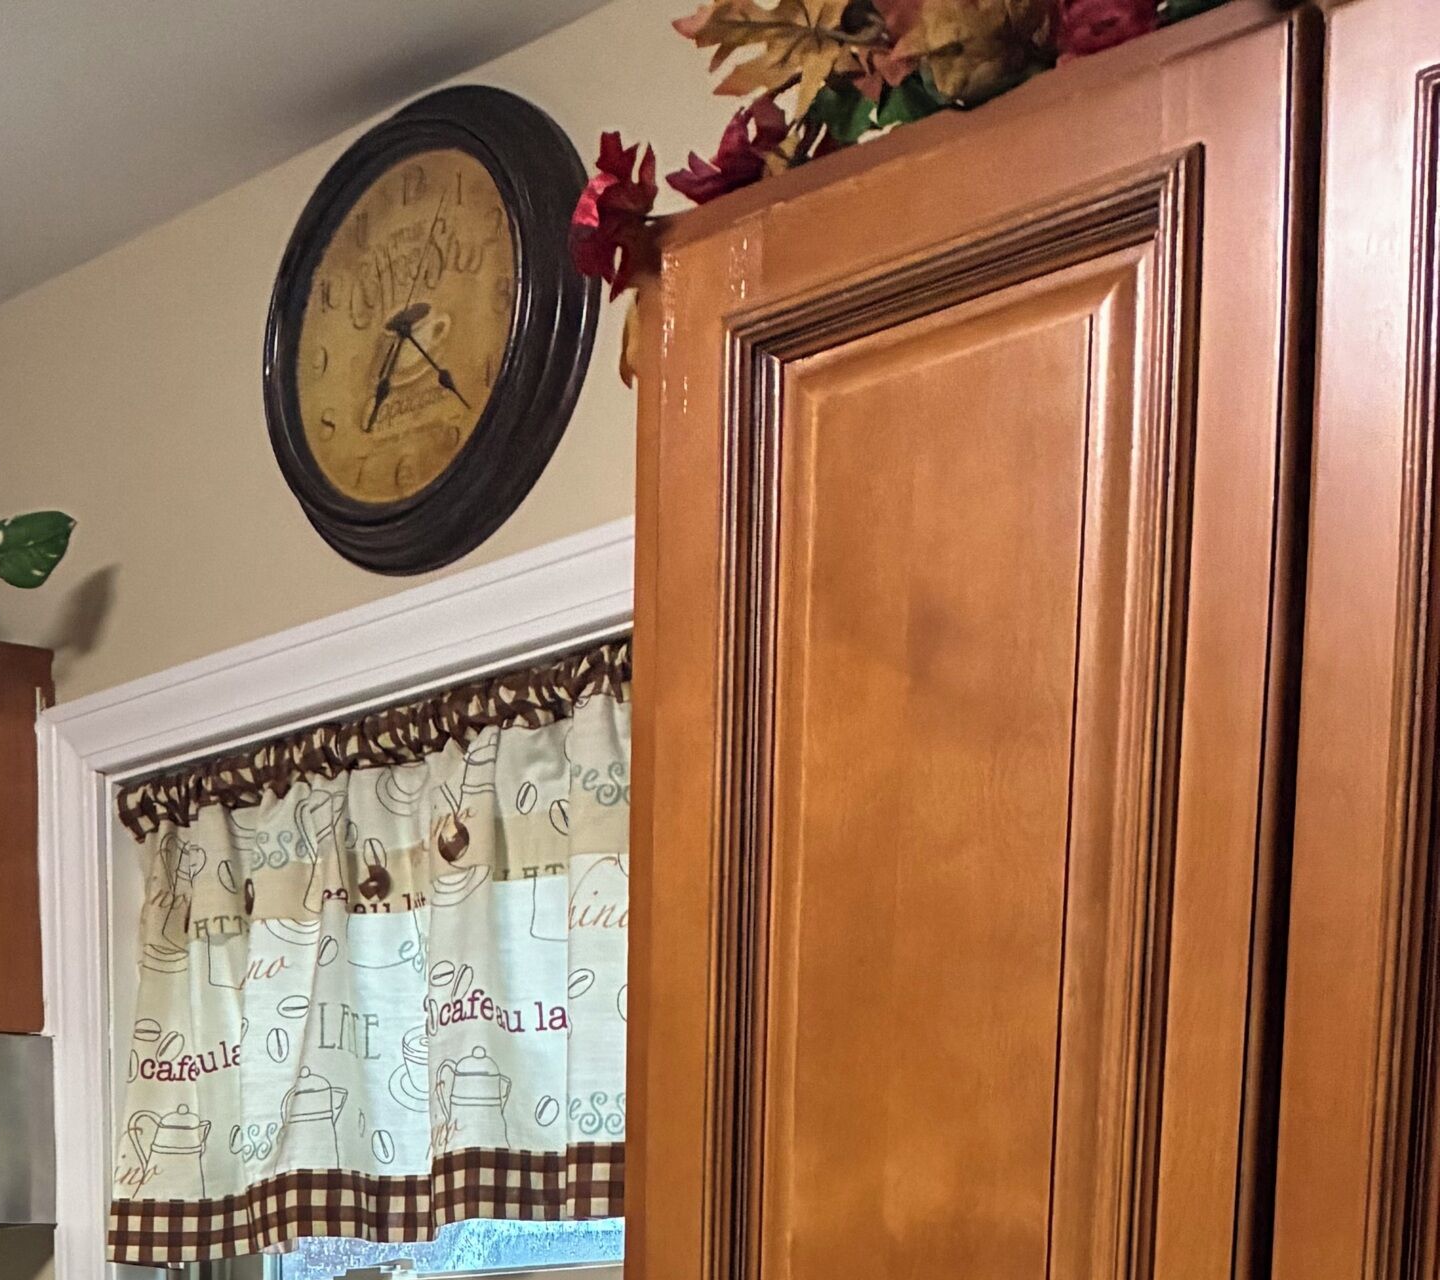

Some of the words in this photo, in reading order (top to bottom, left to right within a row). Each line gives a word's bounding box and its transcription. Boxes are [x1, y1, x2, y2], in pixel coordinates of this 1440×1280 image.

[319, 406, 337, 443] 8
[439, 988, 494, 1027] cafe
[534, 1001, 569, 1032] la
[219, 1041, 241, 1070] la
